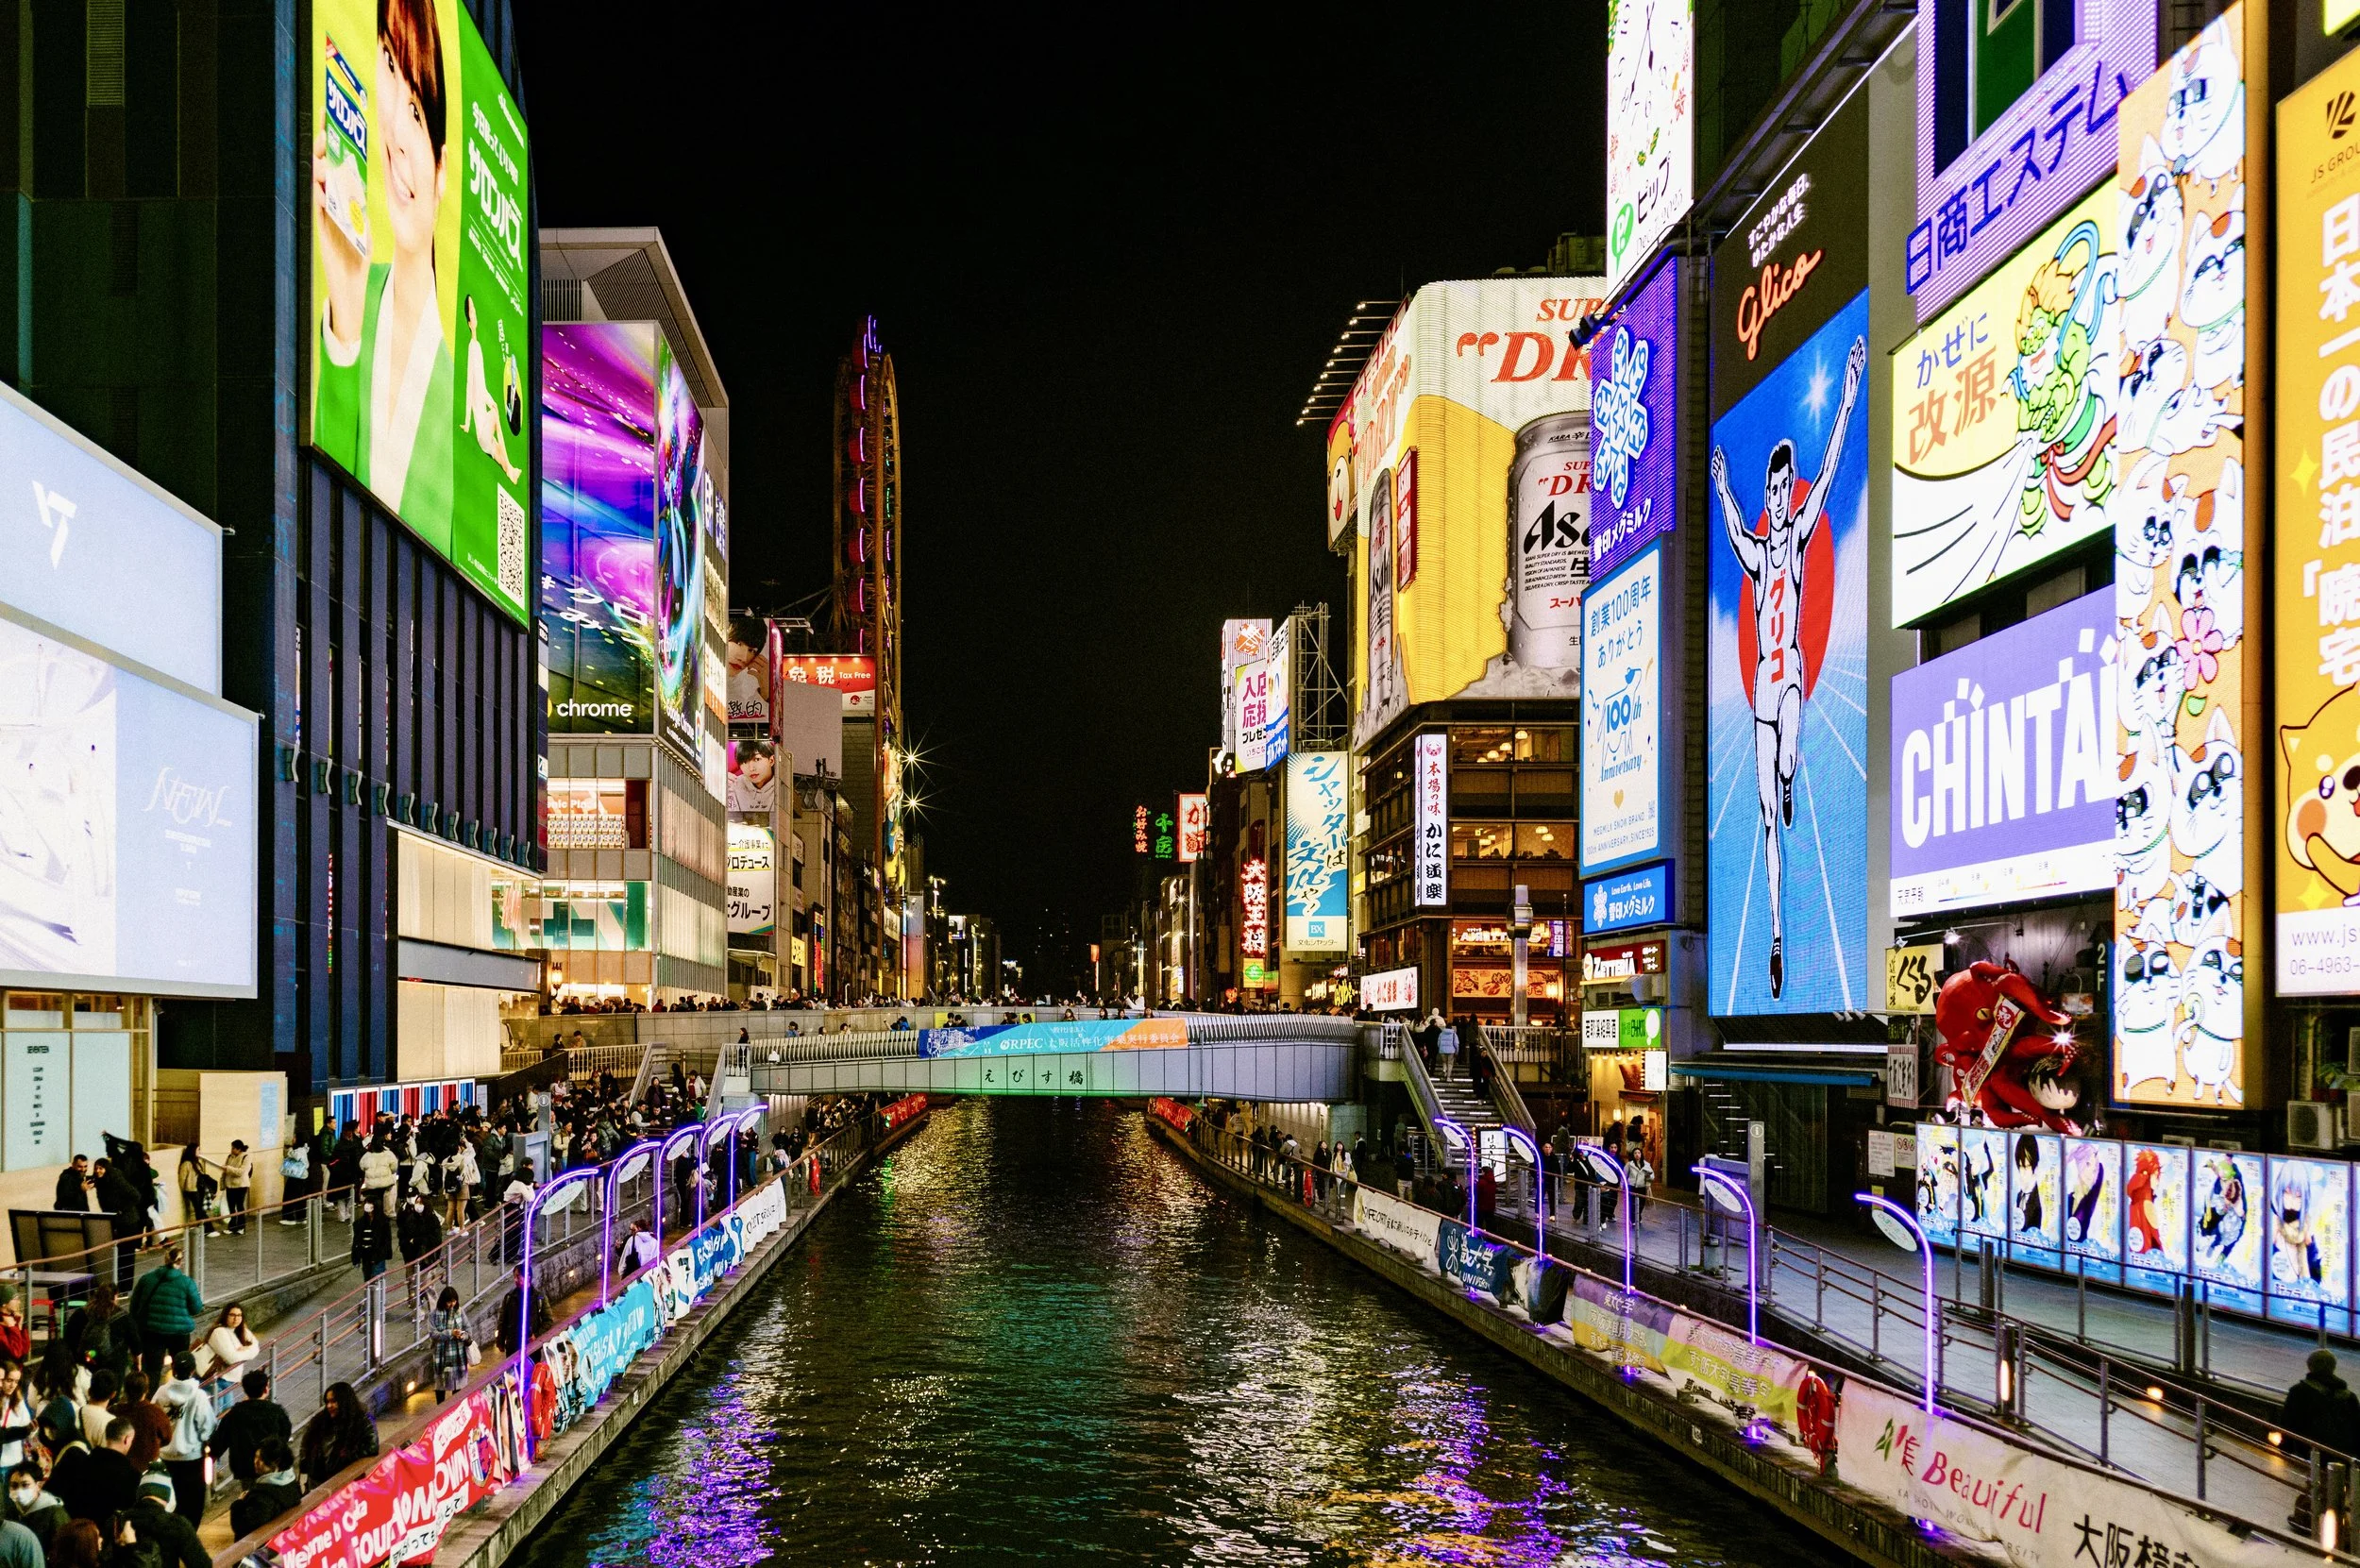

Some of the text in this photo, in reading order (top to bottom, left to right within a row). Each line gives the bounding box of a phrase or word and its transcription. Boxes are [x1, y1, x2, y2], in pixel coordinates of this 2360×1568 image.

[1907, 60, 2129, 295] 日商エステム
[2311, 164, 2325, 184] JS
[469, 137, 523, 272] サロンパス
[1737, 249, 1823, 362] Glico
[1916, 312, 1990, 389] かぜに
[1909, 346, 1998, 465] 改源
[1593, 497, 1651, 562] 雪印メグミルク
[1591, 575, 1652, 637] 創業100周年
[1769, 568, 1787, 683] グリコ
[1597, 620, 1643, 668] ありがとう
[838, 671, 852, 680] Tax
[854, 671, 871, 680] Free
[557, 699, 632, 717] chrome
[1606, 695, 1643, 733] 100th
[1427, 761, 1441, 817] 本場の味
[1598, 754, 1643, 783] Anniversary
[1135, 805, 1148, 853] お好み焼
[1155, 813, 1173, 854] 千房
[1425, 822, 1442, 901] かに道楽
[728, 901, 772, 921] グループ
[1310, 924, 1323, 934] BX
[1609, 894, 1655, 922] 雪印メグミルク
[1896, 954, 1932, 1004] くくる
[984, 1068, 1085, 1086] えびす橋
